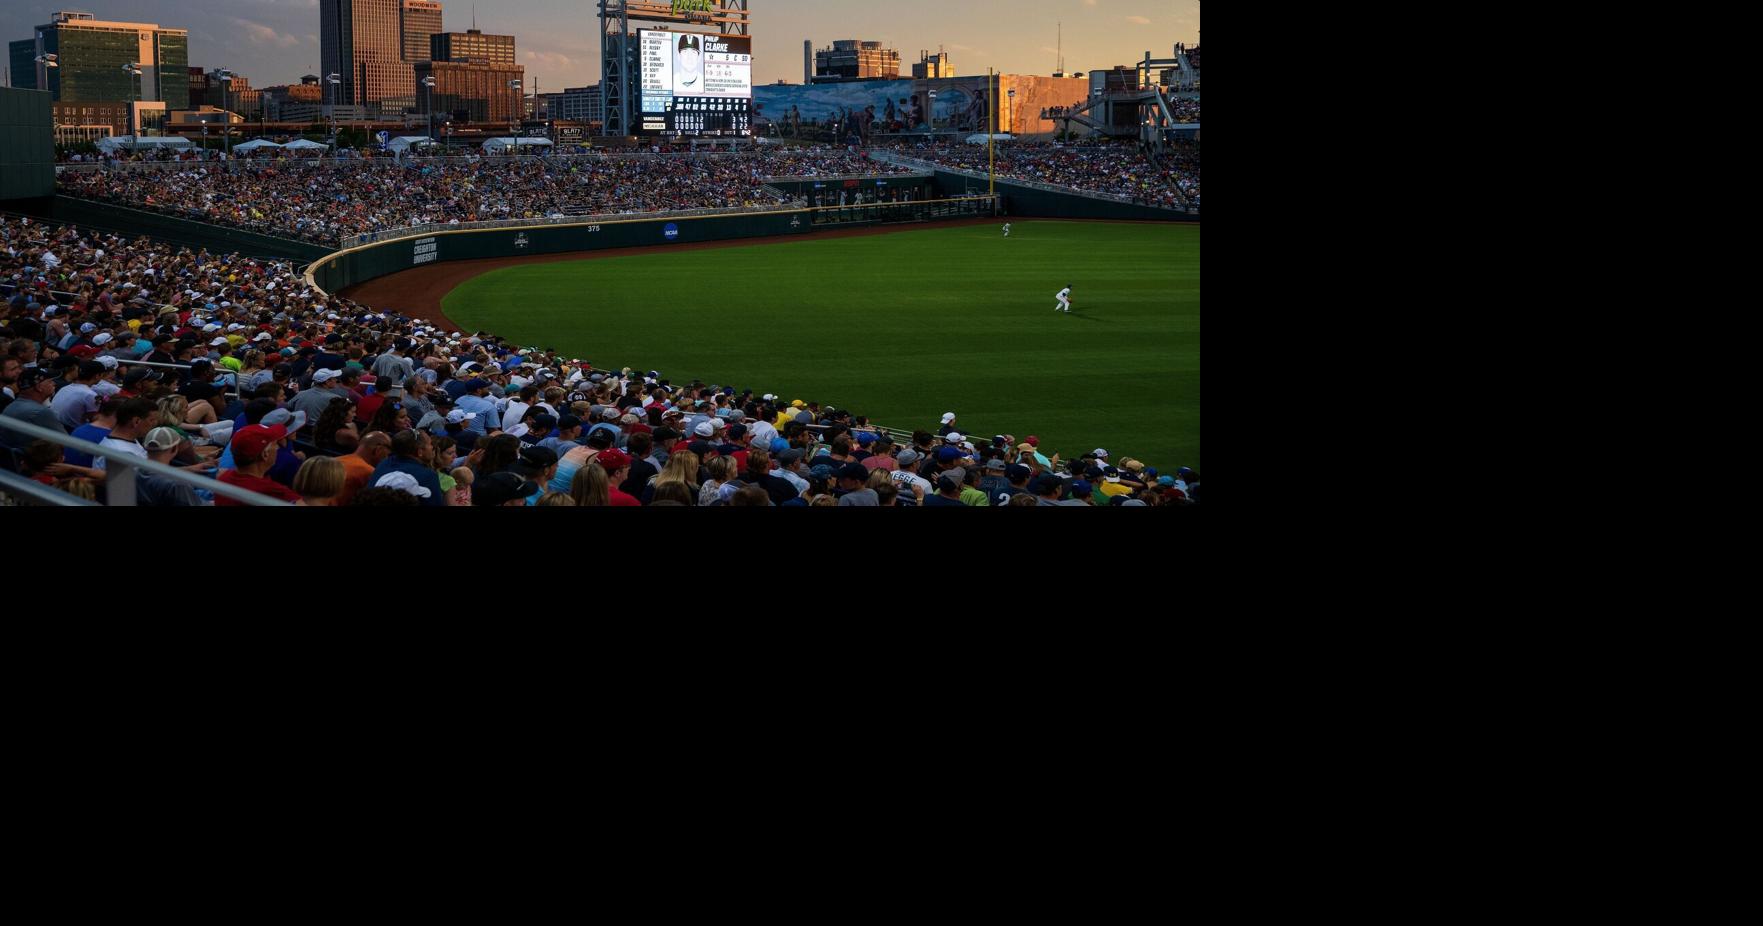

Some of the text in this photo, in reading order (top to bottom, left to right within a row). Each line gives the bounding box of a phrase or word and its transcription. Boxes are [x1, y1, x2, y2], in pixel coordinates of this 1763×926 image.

[705, 42, 728, 52] CLARKE
[414, 242, 437, 255] CREIGHTON
[413, 251, 438, 264] UNIVERSITY
